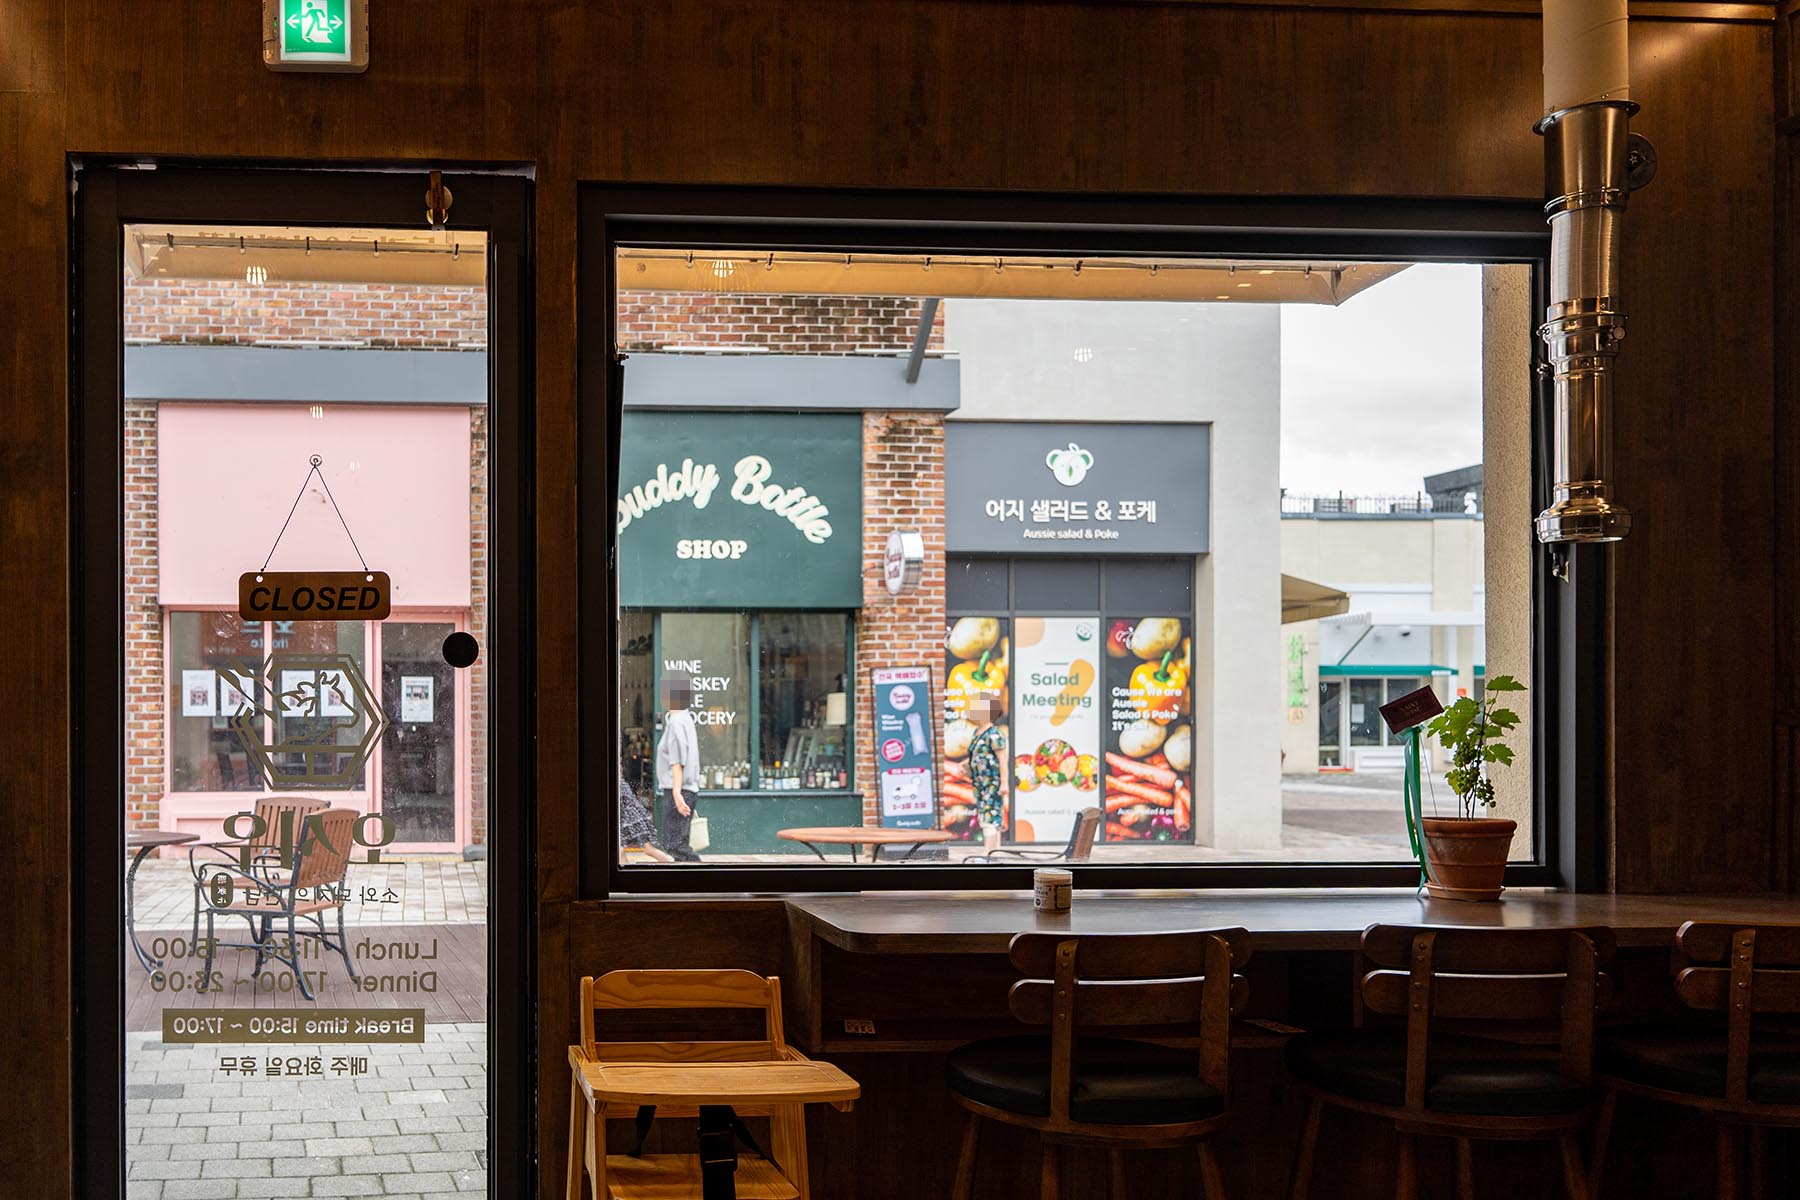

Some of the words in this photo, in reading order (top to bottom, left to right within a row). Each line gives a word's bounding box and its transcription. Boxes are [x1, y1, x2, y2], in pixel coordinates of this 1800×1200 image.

[731, 455, 833, 544] Bottle
[985, 499, 1024, 522] 어지
[1095, 500, 1111, 521] &
[1118, 500, 1157, 523] 포케
[1023, 528, 1056, 540] Aussie
[1057, 528, 1084, 540] salad
[1085, 529, 1093, 539] &
[1094, 528, 1119, 540] Poke
[676, 540, 747, 559] SHOP
[249, 586, 380, 612] CLOSED
[664, 660, 702, 674] WINE
[1031, 672, 1080, 686] Salad
[1112, 687, 1145, 698] Cause
[1164, 688, 1182, 697] are
[1022, 692, 1092, 708] Meeting
[1112, 698, 1148, 708] Aussie
[1112, 709, 1141, 720] Salad
